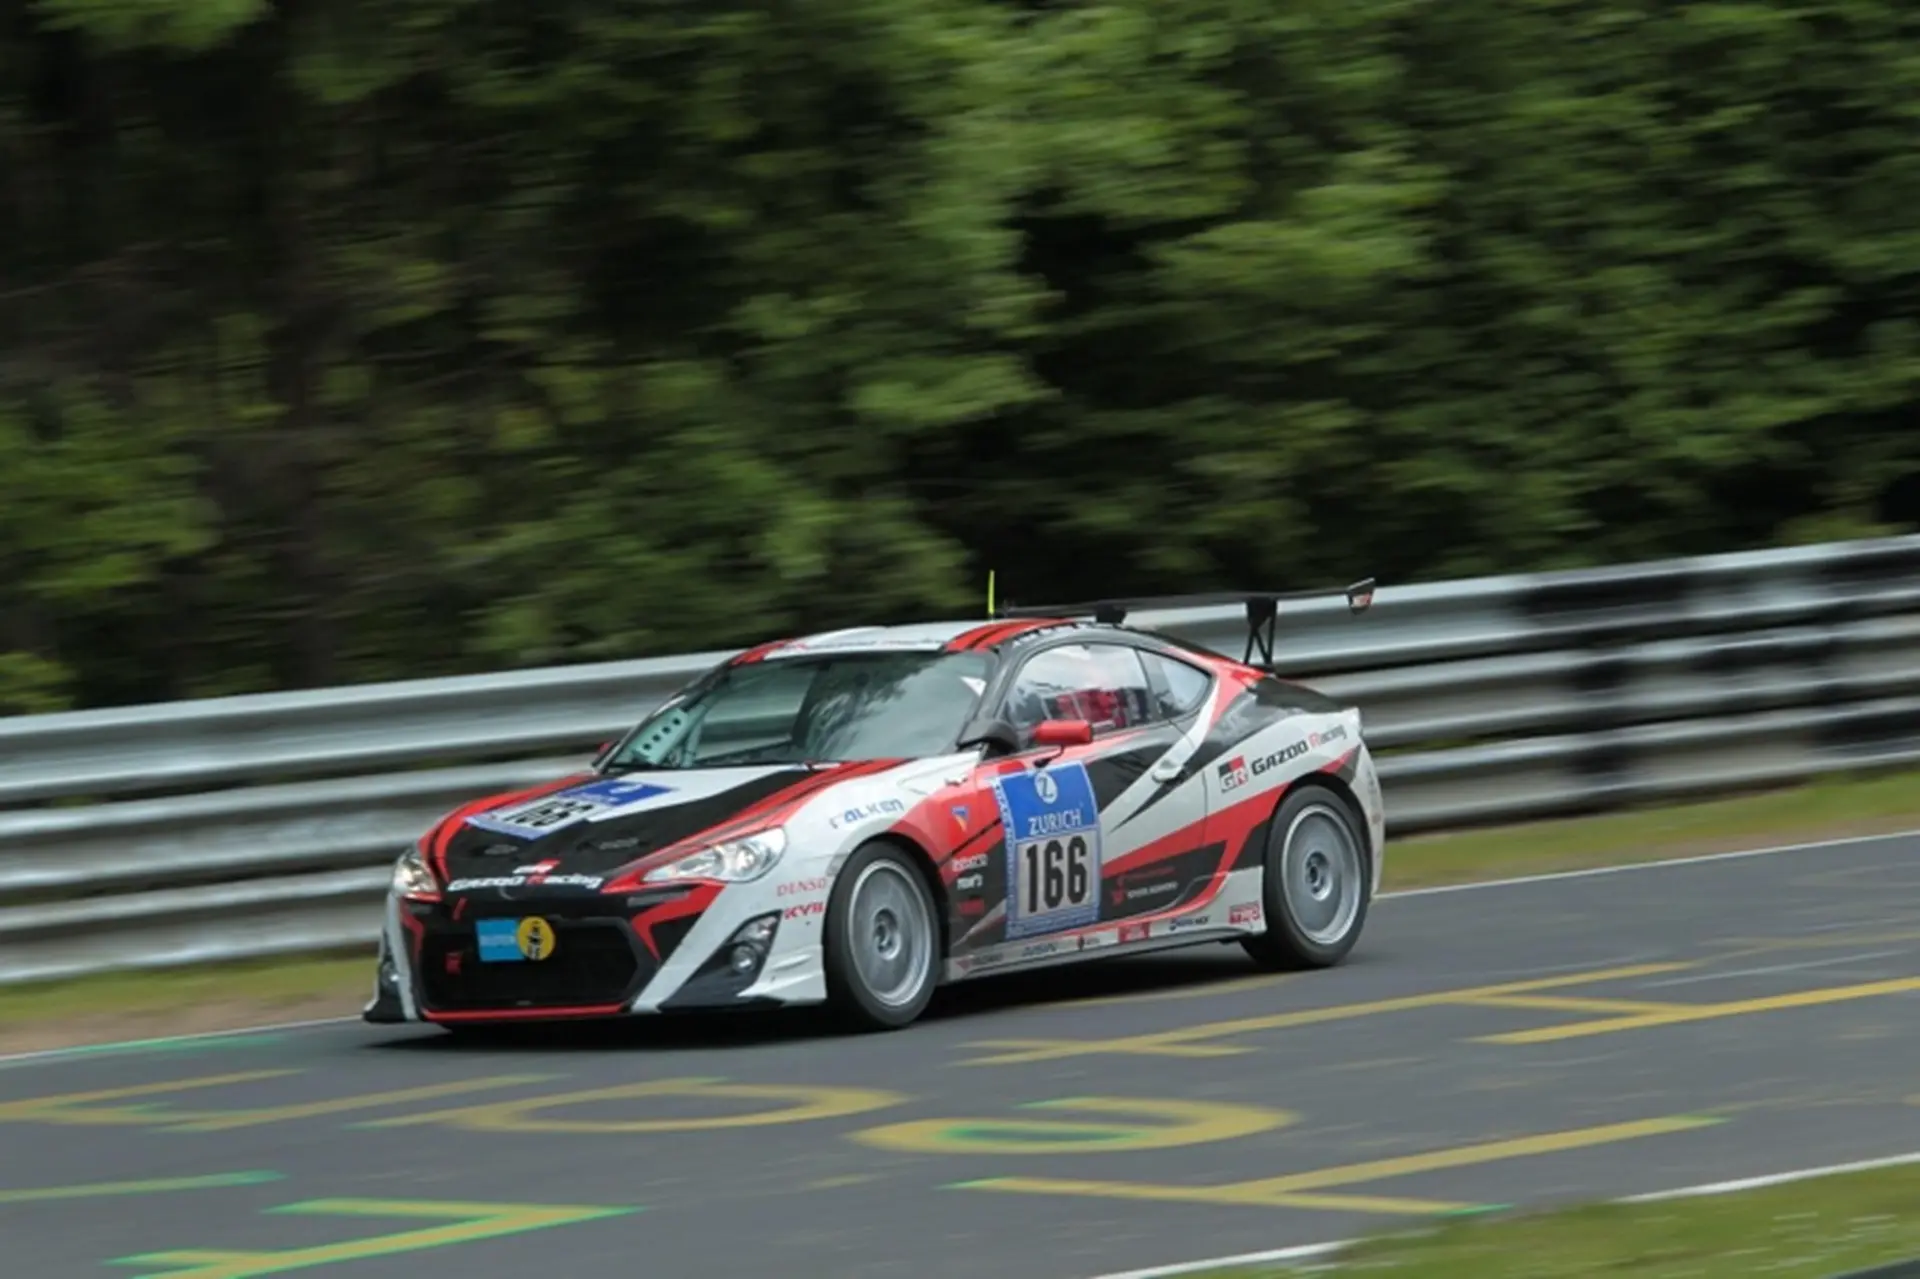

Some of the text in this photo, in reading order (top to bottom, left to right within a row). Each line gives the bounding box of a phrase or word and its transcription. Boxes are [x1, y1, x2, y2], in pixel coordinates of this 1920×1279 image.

[1251, 740, 1309, 776] GAZOO
[1028, 808, 1081, 836] ZURICH
[776, 878, 826, 897] DENSO
[1026, 835, 1087, 914] 166
